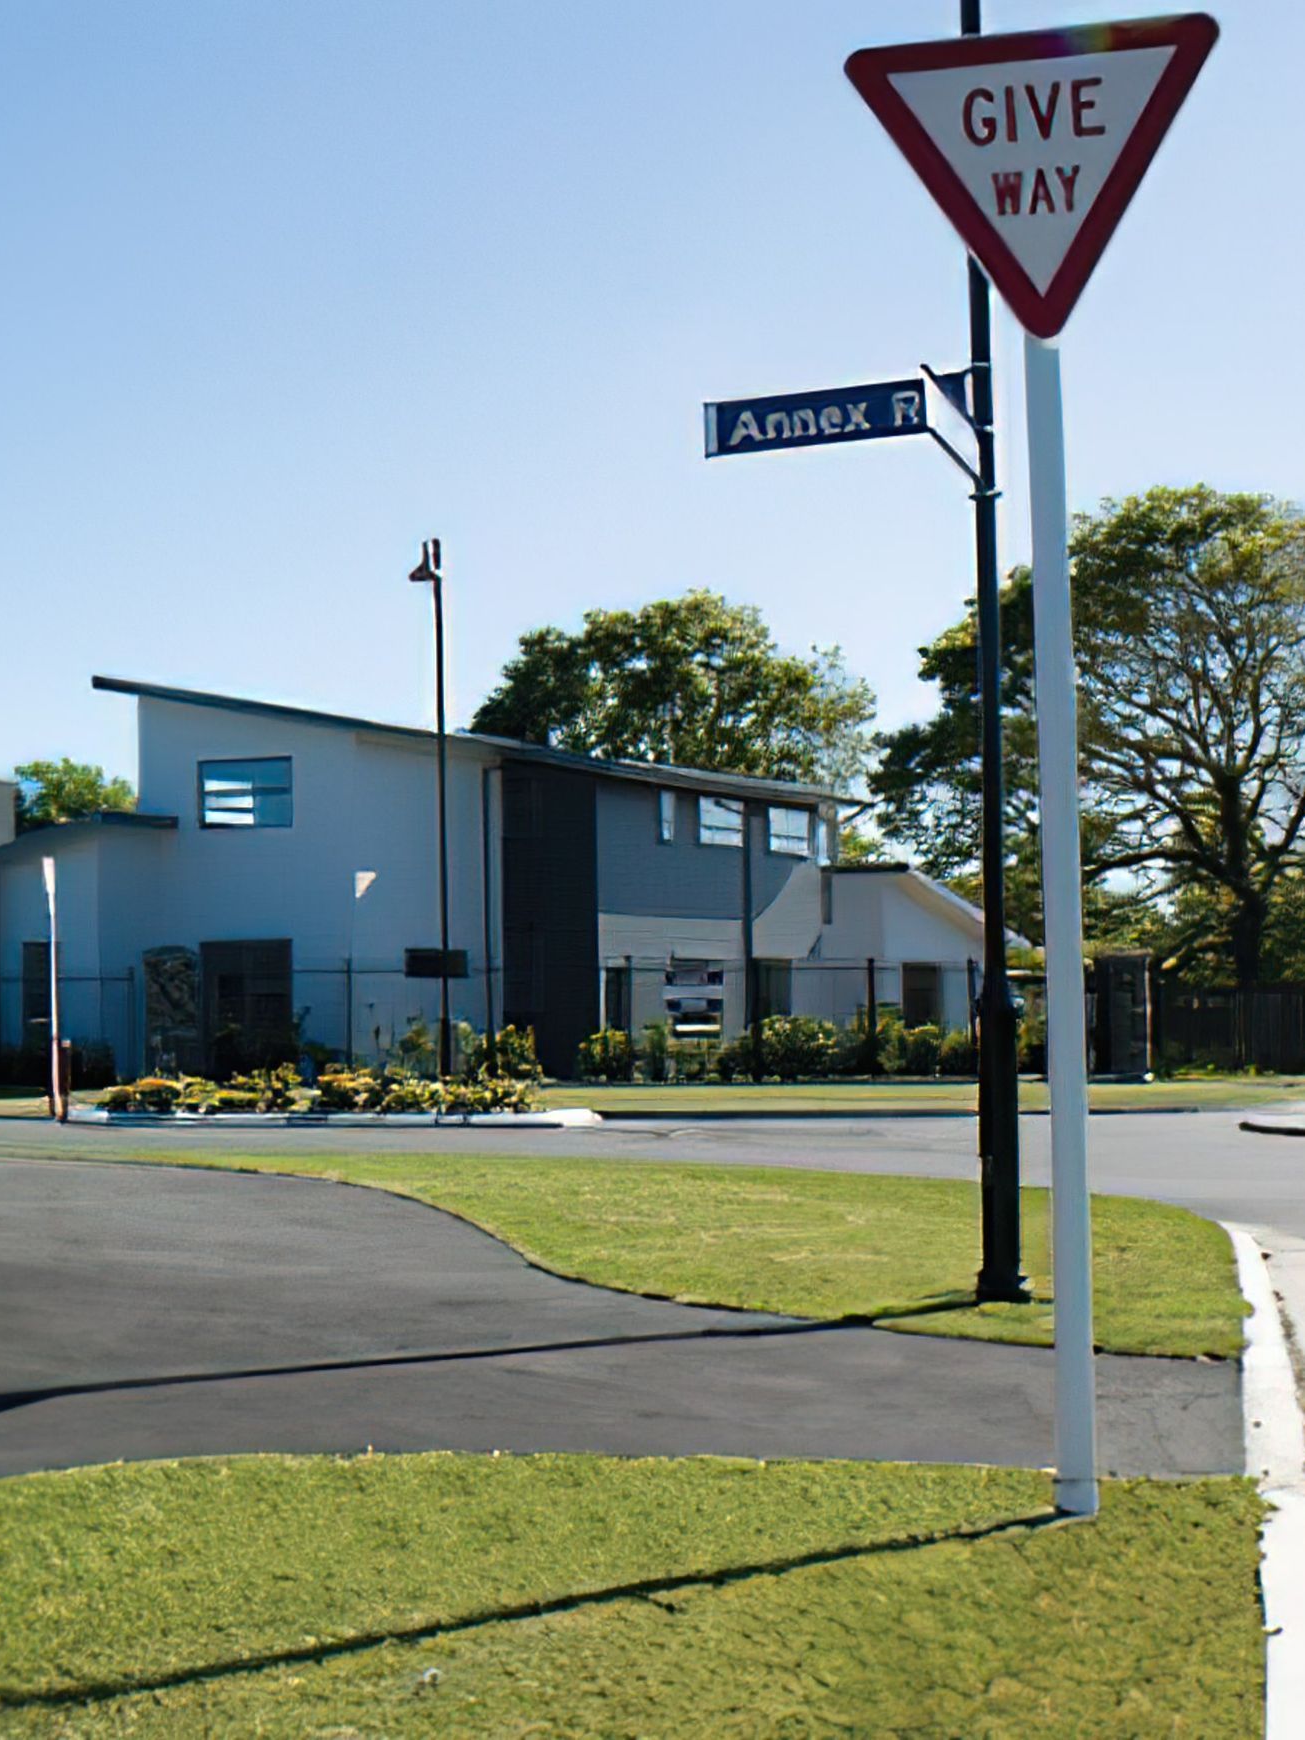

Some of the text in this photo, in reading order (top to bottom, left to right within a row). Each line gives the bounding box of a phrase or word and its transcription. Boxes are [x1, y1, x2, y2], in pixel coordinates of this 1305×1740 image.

[963, 77, 1106, 147] GIVE
[991, 164, 1081, 216] WAY
[726, 390, 920, 446] Annex R
